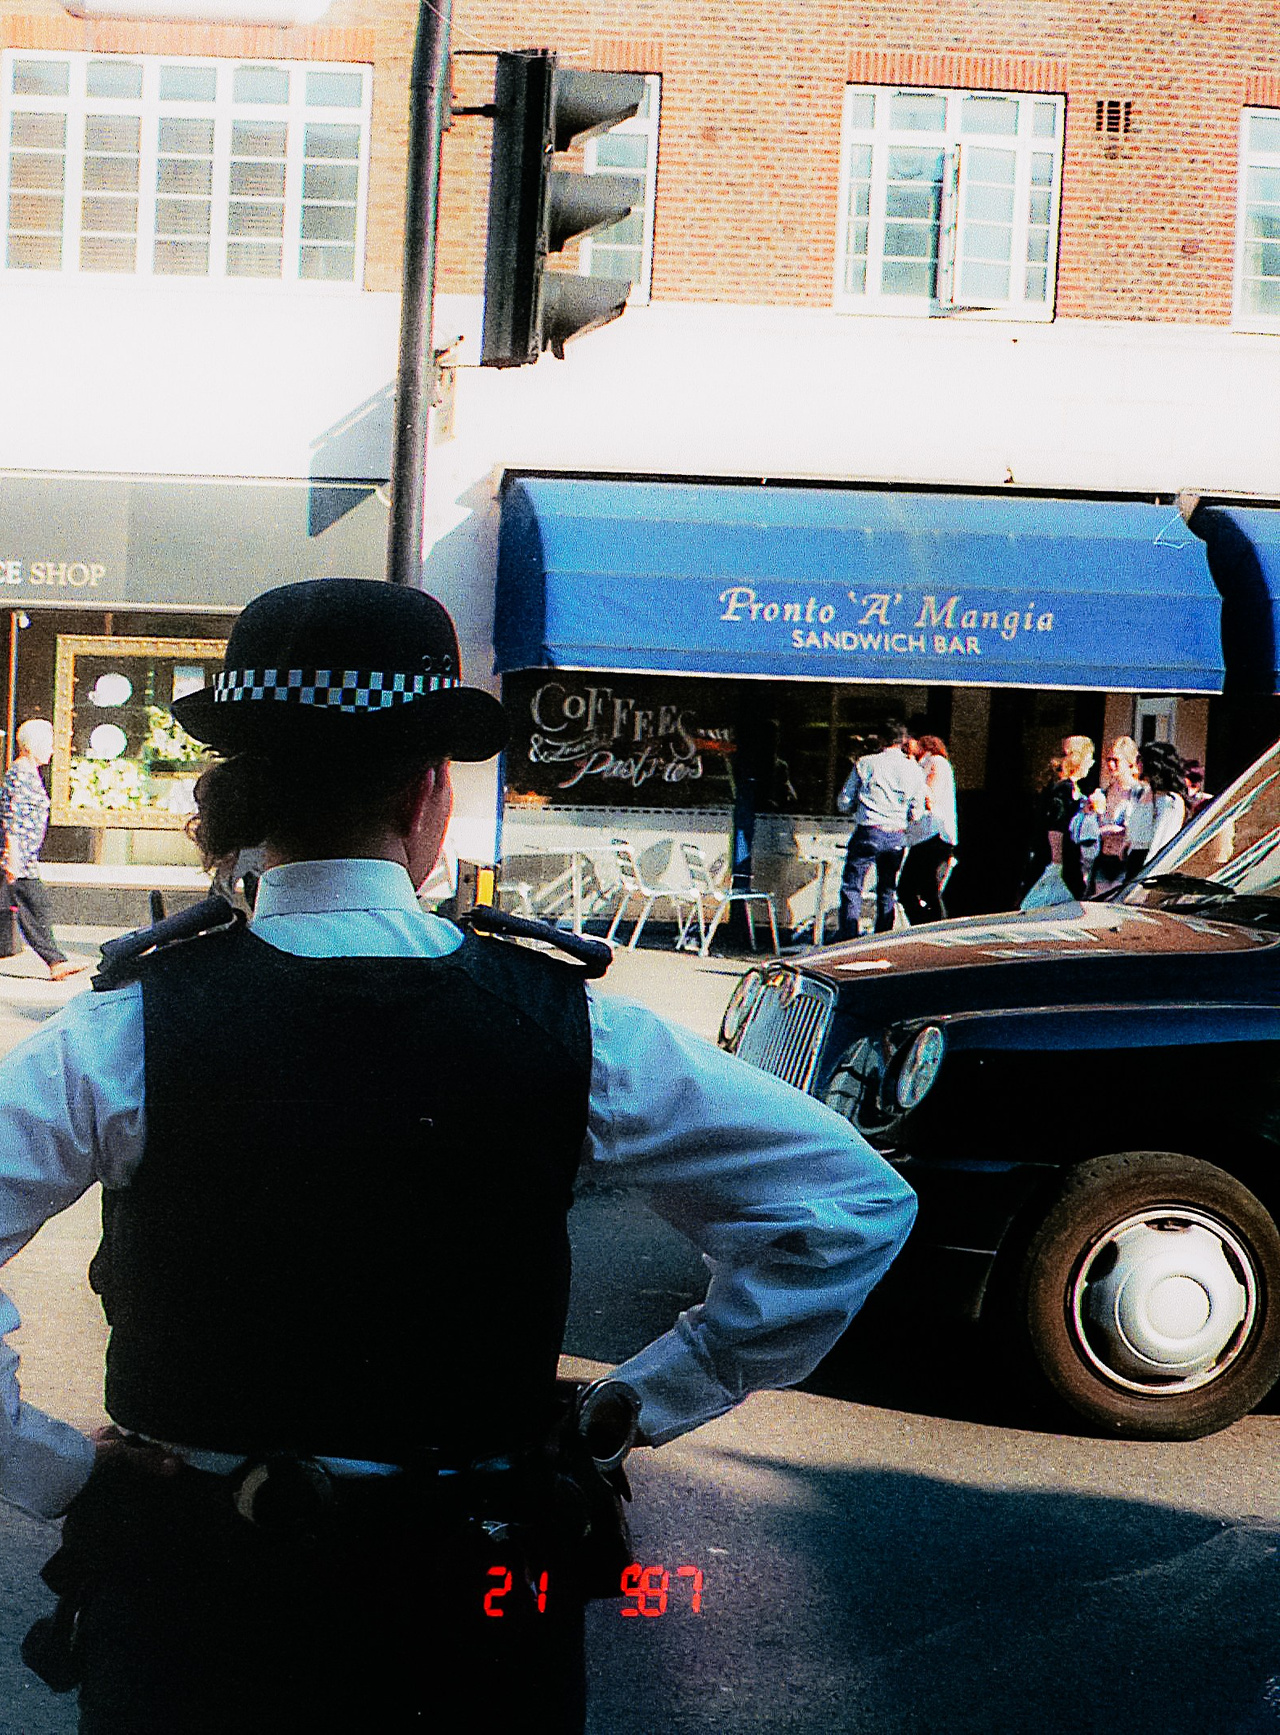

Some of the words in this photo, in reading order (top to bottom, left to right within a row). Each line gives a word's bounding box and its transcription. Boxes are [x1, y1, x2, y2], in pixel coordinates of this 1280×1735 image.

[29, 561, 106, 587] SHOP
[719, 586, 836, 624] Pronto
[913, 595, 1055, 642] Mangia
[791, 629, 926, 655] SANDWICH
[934, 635, 982, 656] BAR
